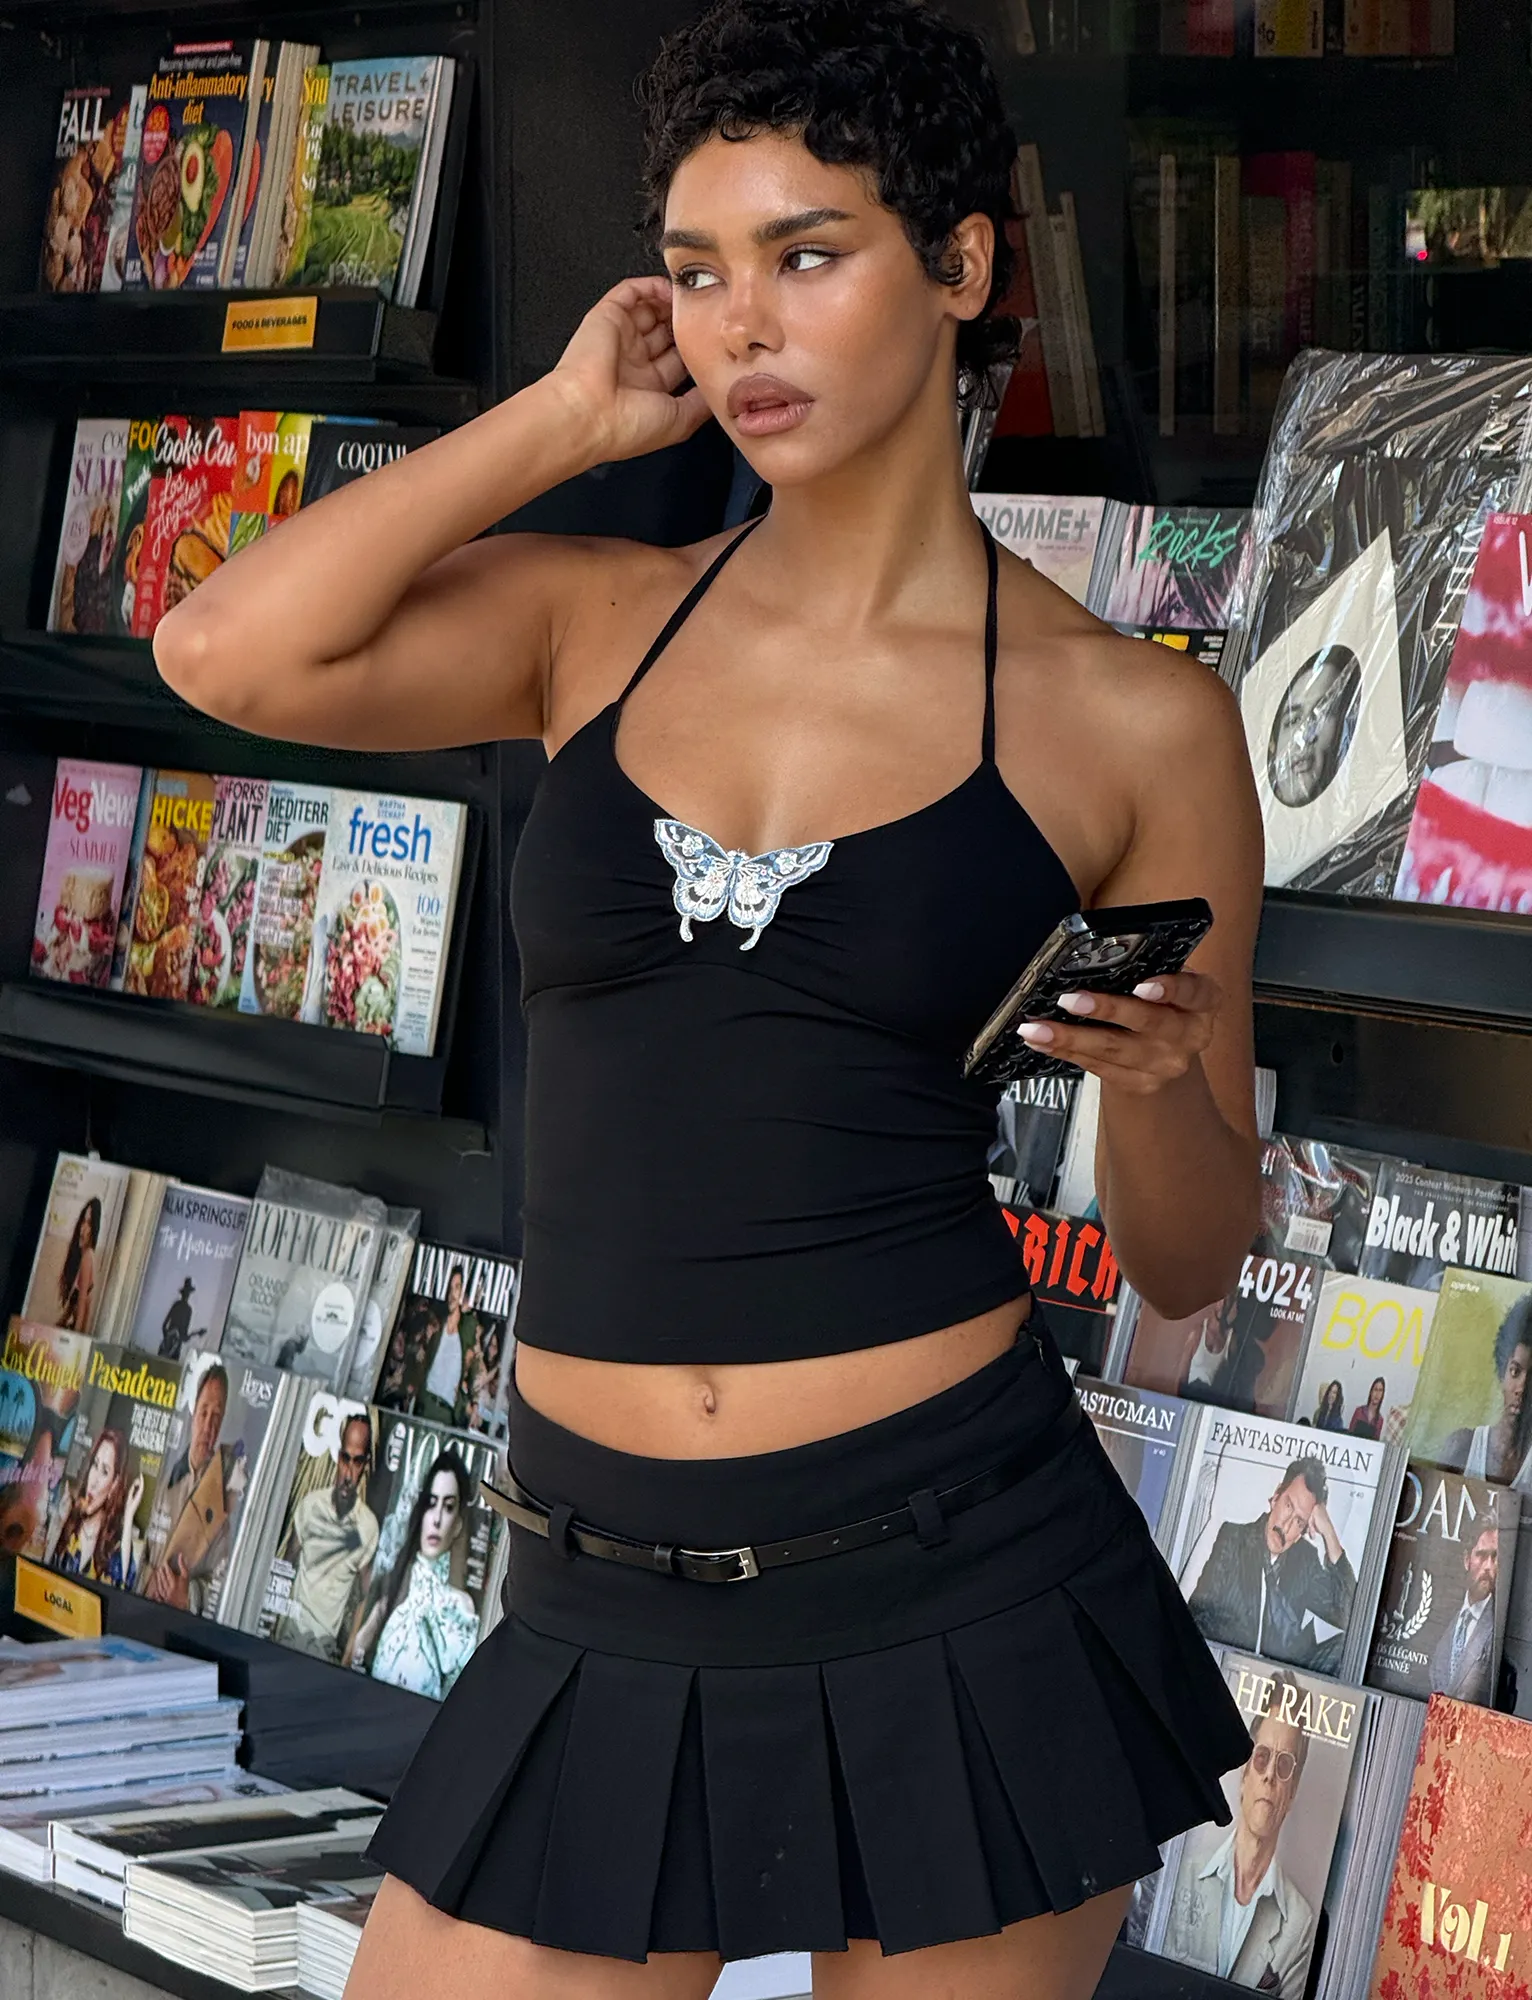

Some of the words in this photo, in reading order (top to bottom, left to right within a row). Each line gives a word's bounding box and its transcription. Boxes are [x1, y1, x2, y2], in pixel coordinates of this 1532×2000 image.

[149, 71, 249, 102] Anti-inflammatory
[56, 97, 105, 143] FALL
[183, 99, 204, 125] diet
[332, 98, 426, 124] LEISURE
[232, 319, 253, 330] FOOD
[261, 314, 308, 328] BEVERAGES
[153, 421, 203, 468] Cook's
[246, 424, 279, 454] bon
[228, 779, 265, 802] FORKS
[211, 800, 264, 843] PLANT
[268, 795, 329, 826] MEDITERR
[264, 820, 291, 843] DIET
[348, 805, 432, 864] fresh
[361, 859, 403, 879] Delicious
[404, 864, 440, 885] Recipes
[416, 892, 442, 916] 100
[185, 1201, 232, 1228] SPRINGS
[1365, 1195, 1441, 1263] Black
[1440, 1209, 1462, 1264] &
[467, 1257, 516, 1318] FAIR
[1238, 1255, 1313, 1311] 4024
[1270, 1307, 1287, 1320] LOOK
[1287, 1310, 1296, 1321] AT
[1295, 1312, 1306, 1324] ME
[88, 1350, 177, 1409] Pasadena
[1210, 1421, 1374, 1474] FANTASTICMAN
[44, 1589, 74, 1615] LOCAL
[1275, 1682, 1356, 1744] RAKE
